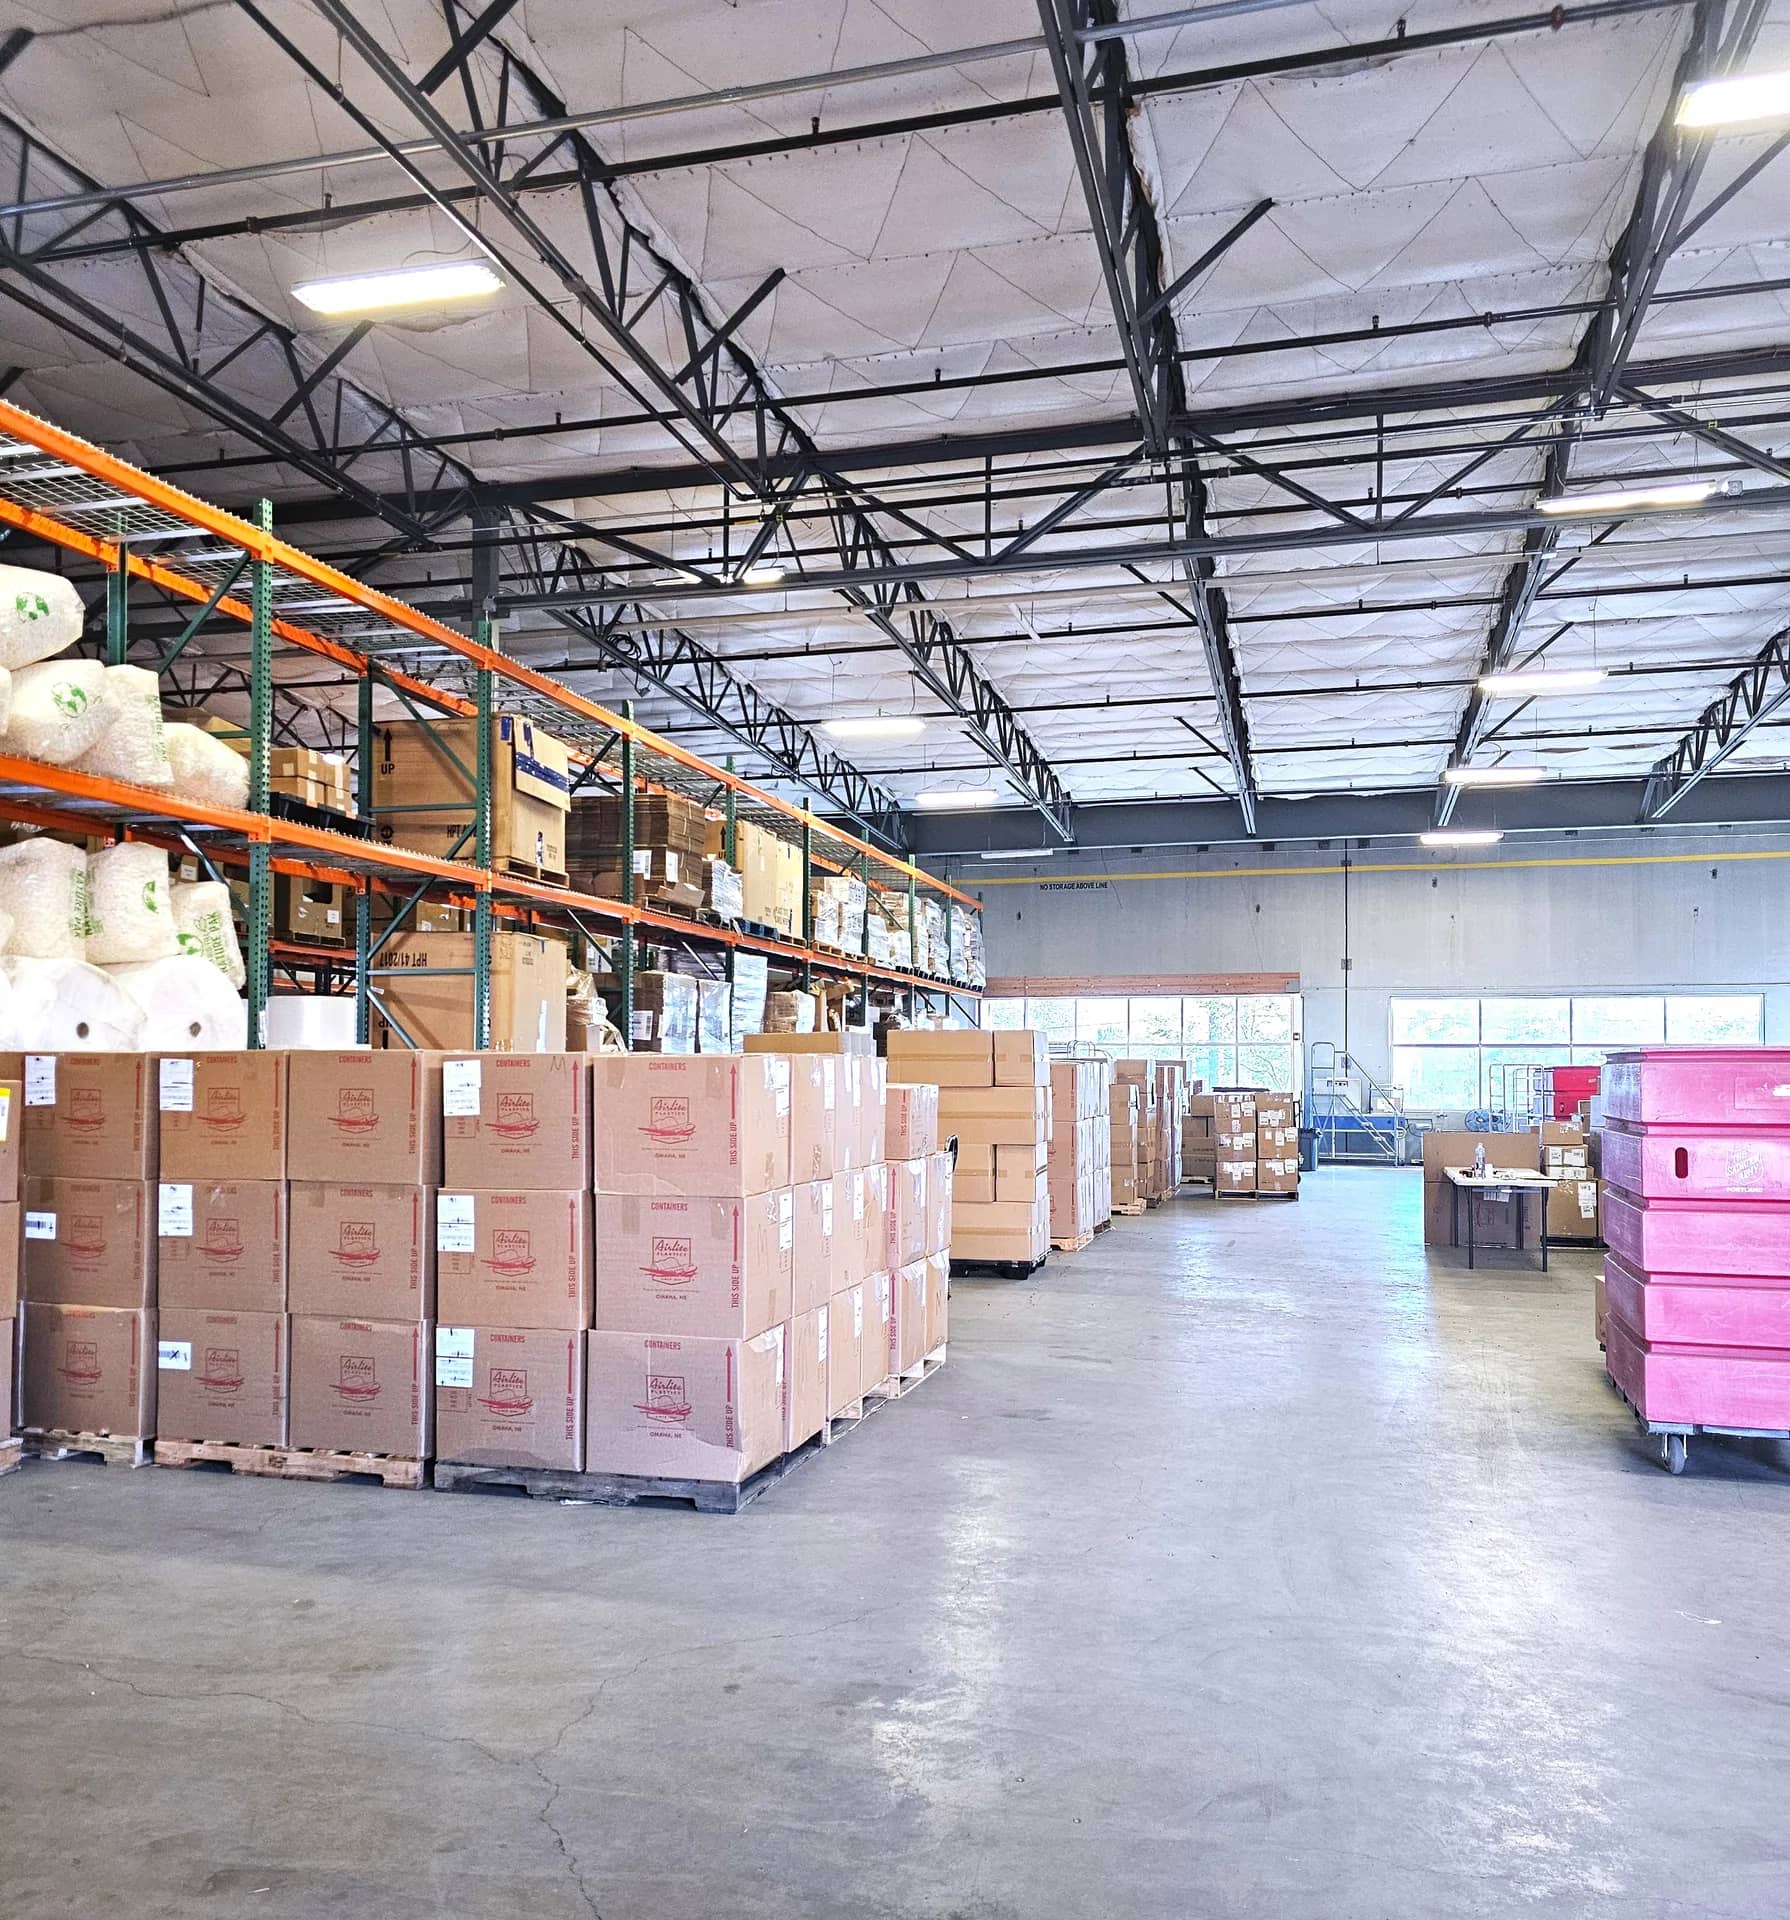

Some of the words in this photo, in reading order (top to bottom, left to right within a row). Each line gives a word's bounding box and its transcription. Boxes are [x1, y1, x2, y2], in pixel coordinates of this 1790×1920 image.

[381, 763, 395, 775] UP
[206, 912, 220, 932] PAK
[412, 952, 427, 967] HPT
[648, 1062, 687, 1071] CONTAINERS
[500, 1096, 530, 1107] Airlite
[654, 1099, 687, 1111] Airlite
[571, 1117, 579, 1127] UP
[729, 1121, 737, 1131] UP
[571, 1128, 579, 1143] SIDE
[729, 1134, 737, 1149] SIDE
[571, 1144, 579, 1159] THIS
[729, 1150, 737, 1165] THIS
[491, 1196, 527, 1205] CONTAINERS
[651, 1202, 689, 1211] CONTAINERS
[496, 1232, 528, 1244] Airlite
[655, 1240, 688, 1252] Airlite
[568, 1256, 576, 1265] UP
[568, 1268, 576, 1282] SIDE
[731, 1264, 740, 1274] UP
[731, 1276, 740, 1291] SIDE
[568, 1283, 576, 1298] THIS
[731, 1293, 740, 1308] THIS
[490, 1334, 526, 1343] CONTAINERS
[644, 1339, 681, 1350] CONTAINERS
[493, 1371, 524, 1384] Airlite
[649, 1378, 682, 1391] Airlite
[566, 1396, 574, 1406] UP
[566, 1408, 574, 1424] SIDE
[725, 1405, 734, 1415] UP
[725, 1417, 734, 1432] SIDE
[566, 1425, 574, 1440] THIS
[725, 1433, 734, 1448] THIS
